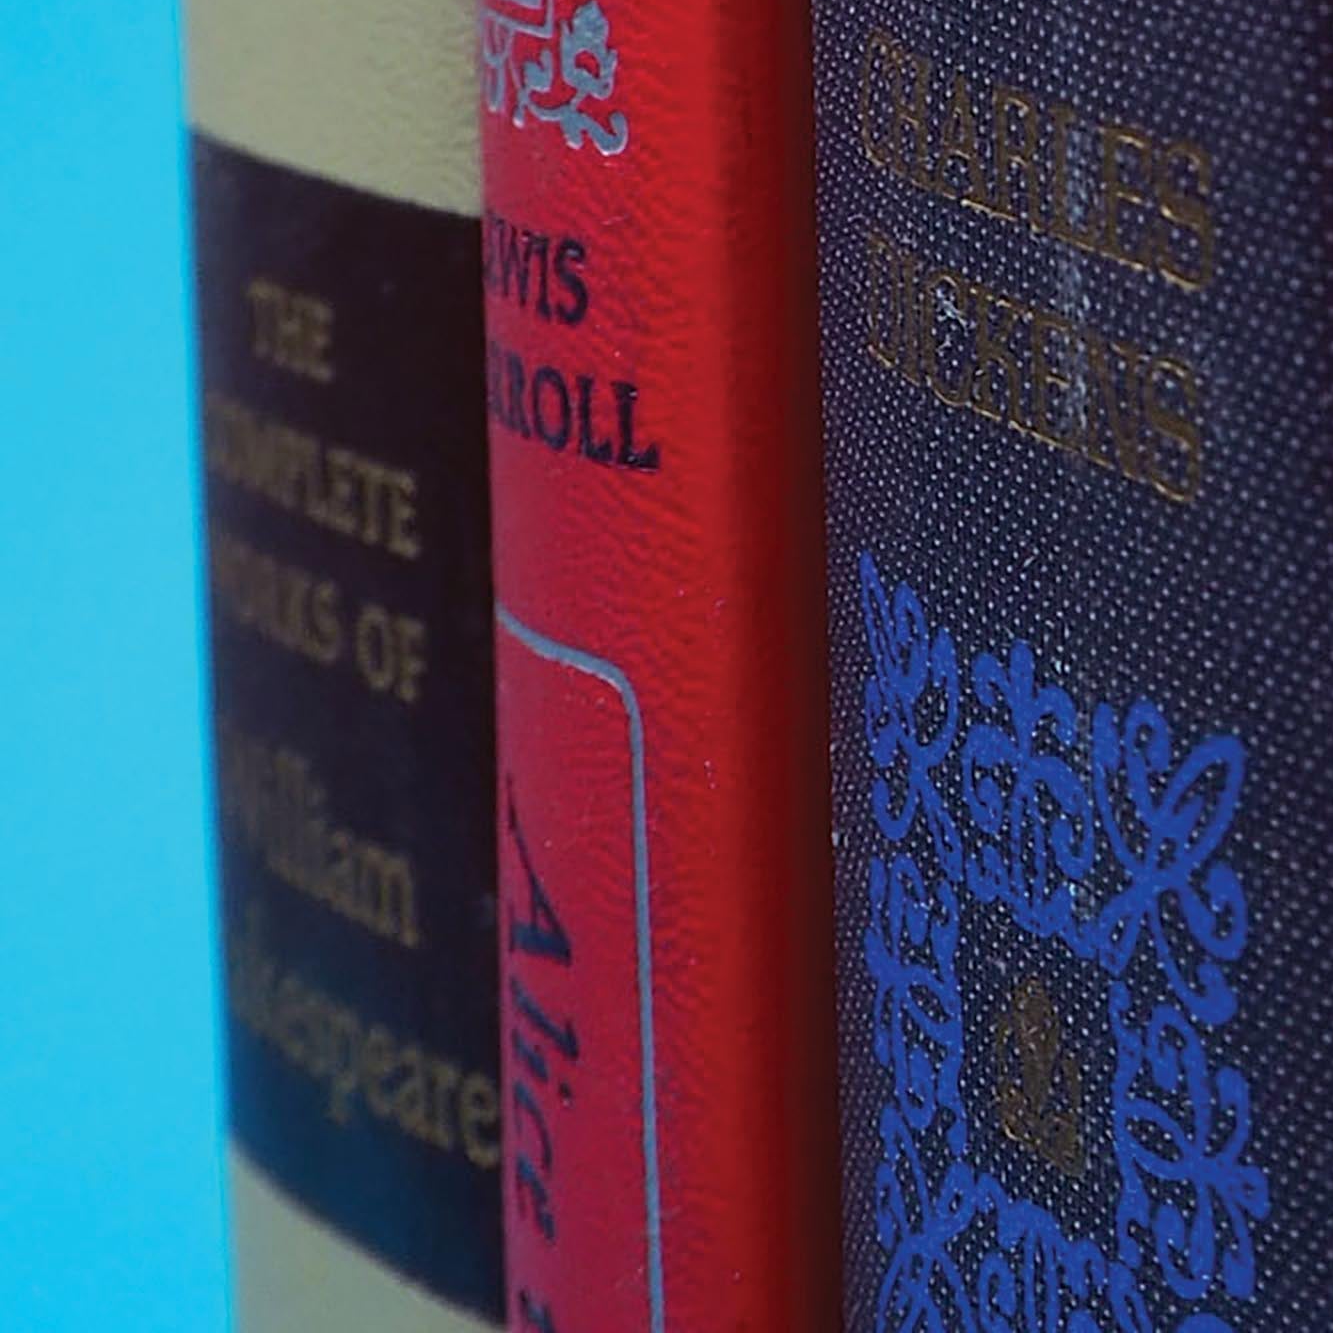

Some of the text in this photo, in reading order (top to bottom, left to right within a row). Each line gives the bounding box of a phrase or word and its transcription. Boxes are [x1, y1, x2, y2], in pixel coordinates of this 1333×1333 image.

[862, 31, 1214, 293] CHARLES
[245, 278, 335, 383] THE
[484, 211, 589, 326] WIS
[486, 339, 660, 472] ROLL
[866, 233, 1202, 505] DICKENS
[208, 393, 422, 559] OMPLETE
[355, 601, 428, 703] OF
[230, 905, 499, 1170] kespeare
[505, 771, 579, 1241] Alice
